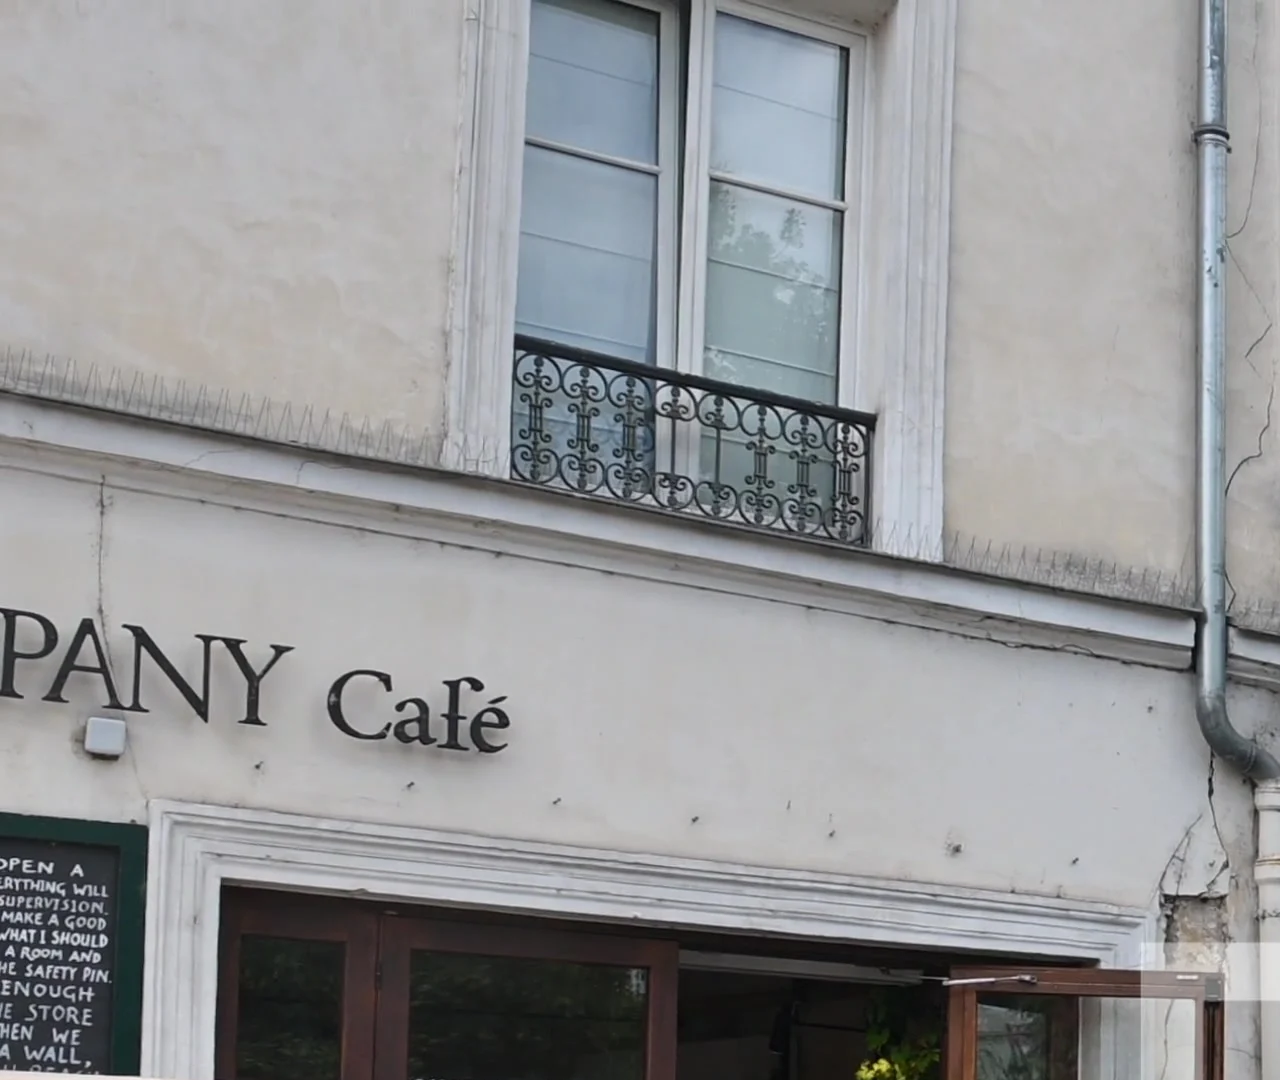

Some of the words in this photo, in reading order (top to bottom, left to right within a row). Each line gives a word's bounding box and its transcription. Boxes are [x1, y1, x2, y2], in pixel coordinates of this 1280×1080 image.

[0, 608, 295, 727] PANY
[327, 669, 512, 754] Café
[70, 864, 84, 877] A
[72, 883, 109, 897] WILL
[0, 894, 108, 915] SUPERVISION.
[1, 911, 43, 926] MAKE
[47, 913, 59, 926] A
[64, 915, 107, 930] GOOD
[39, 930, 46, 944] I
[51, 930, 109, 948] SHOULD
[4, 945, 16, 958] A
[20, 946, 64, 961] ROOM
[68, 949, 101, 964] AND
[24, 963, 77, 981] SAFETY
[83, 966, 112, 984] PIN.
[0, 979, 95, 1003] ENOUGH
[24, 1003, 93, 1026] STORE
[52, 1028, 82, 1045] WE
[23, 1045, 91, 1068] WALL,
